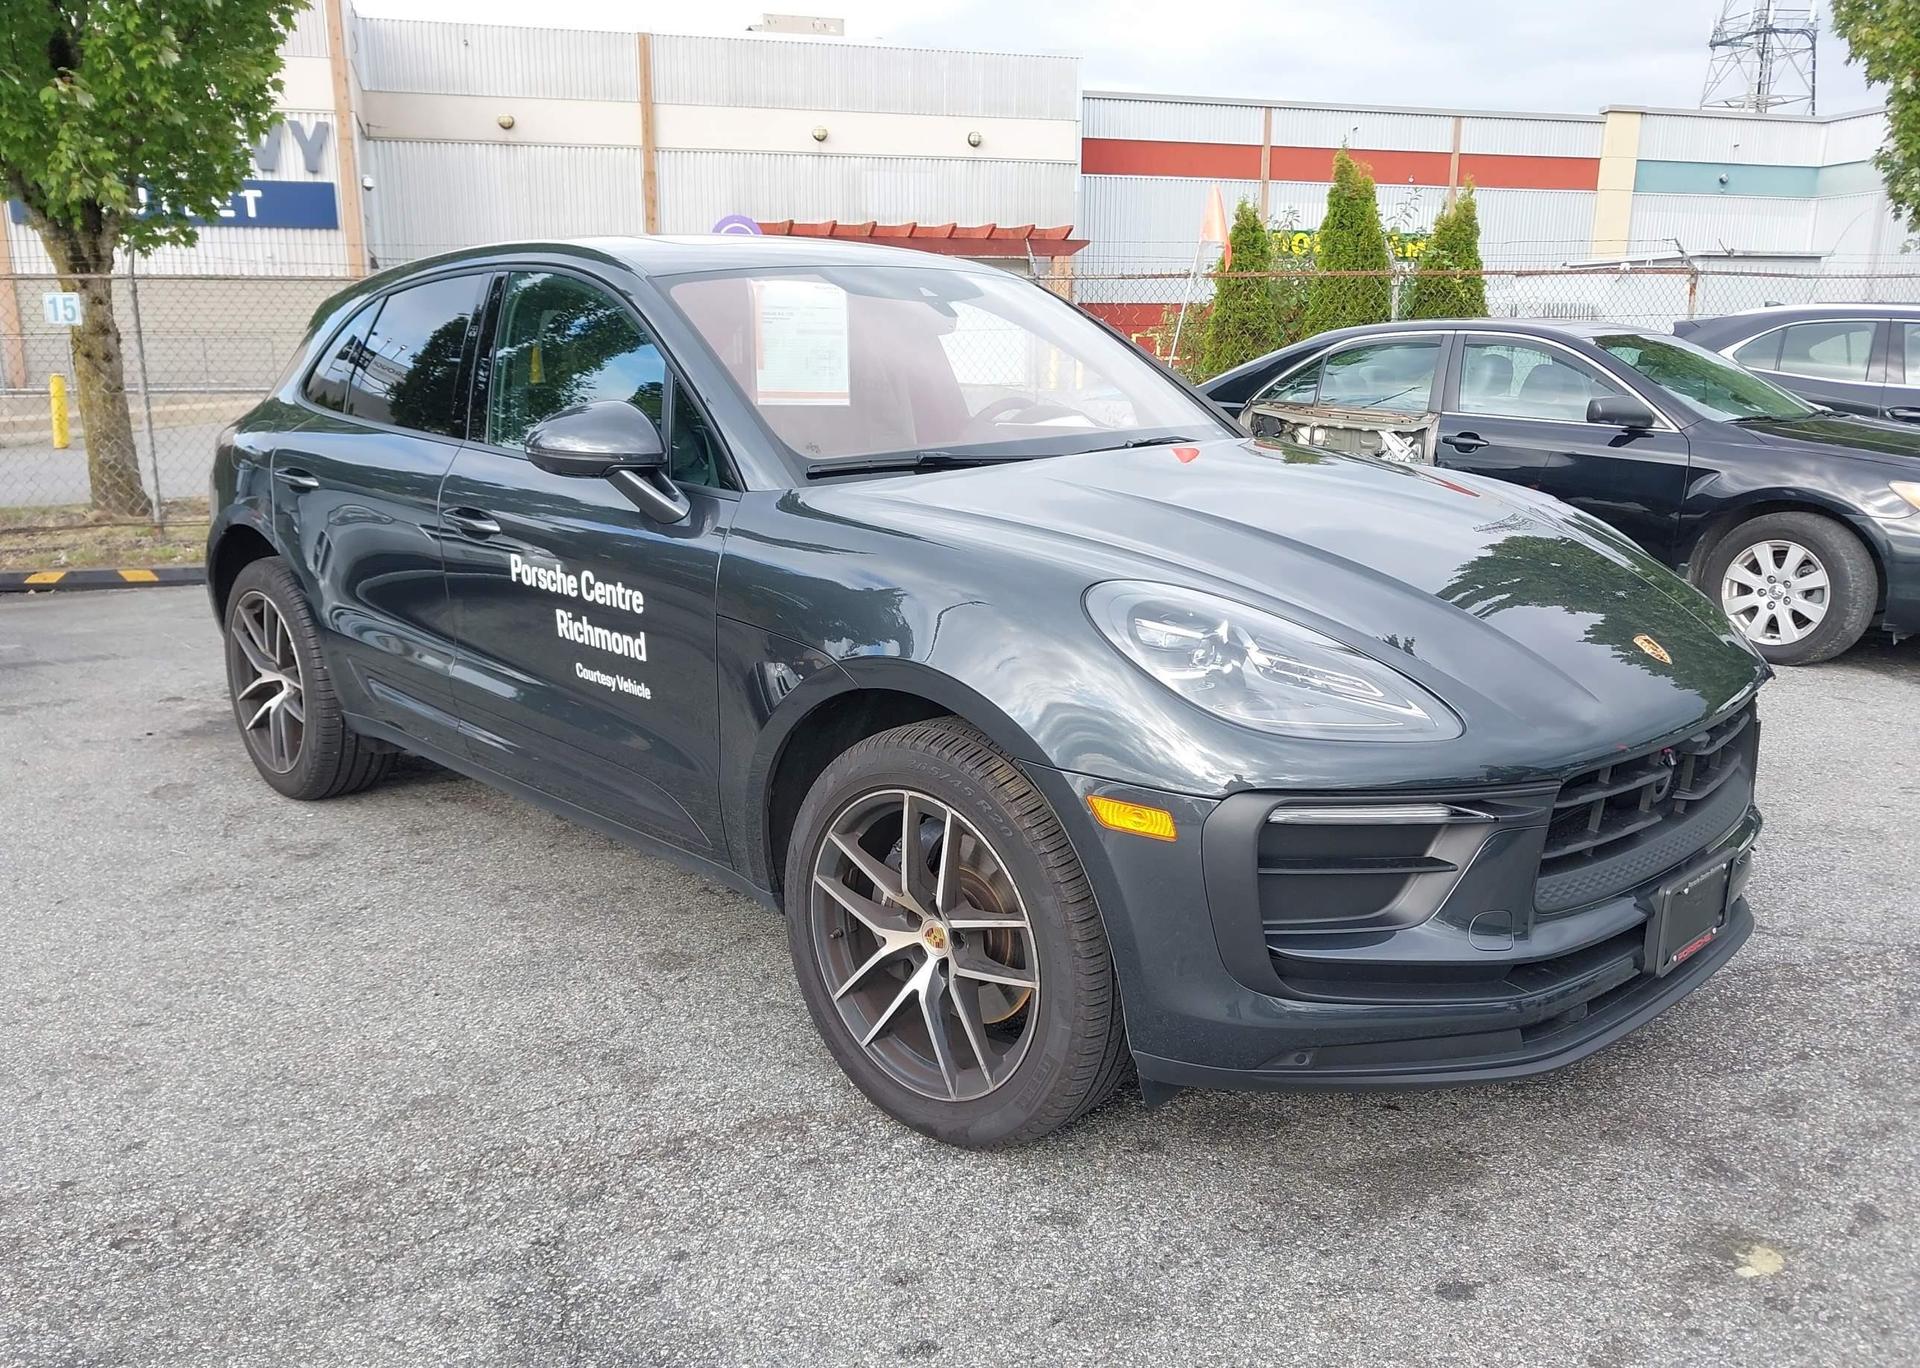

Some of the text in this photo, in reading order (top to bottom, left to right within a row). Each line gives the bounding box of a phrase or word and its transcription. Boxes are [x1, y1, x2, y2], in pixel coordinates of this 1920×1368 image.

[48, 296, 77, 322] 15
[510, 553, 644, 614] Porsche Centre
[555, 608, 647, 662] Richmond
[575, 662, 652, 699] Courtesy Vehicle
